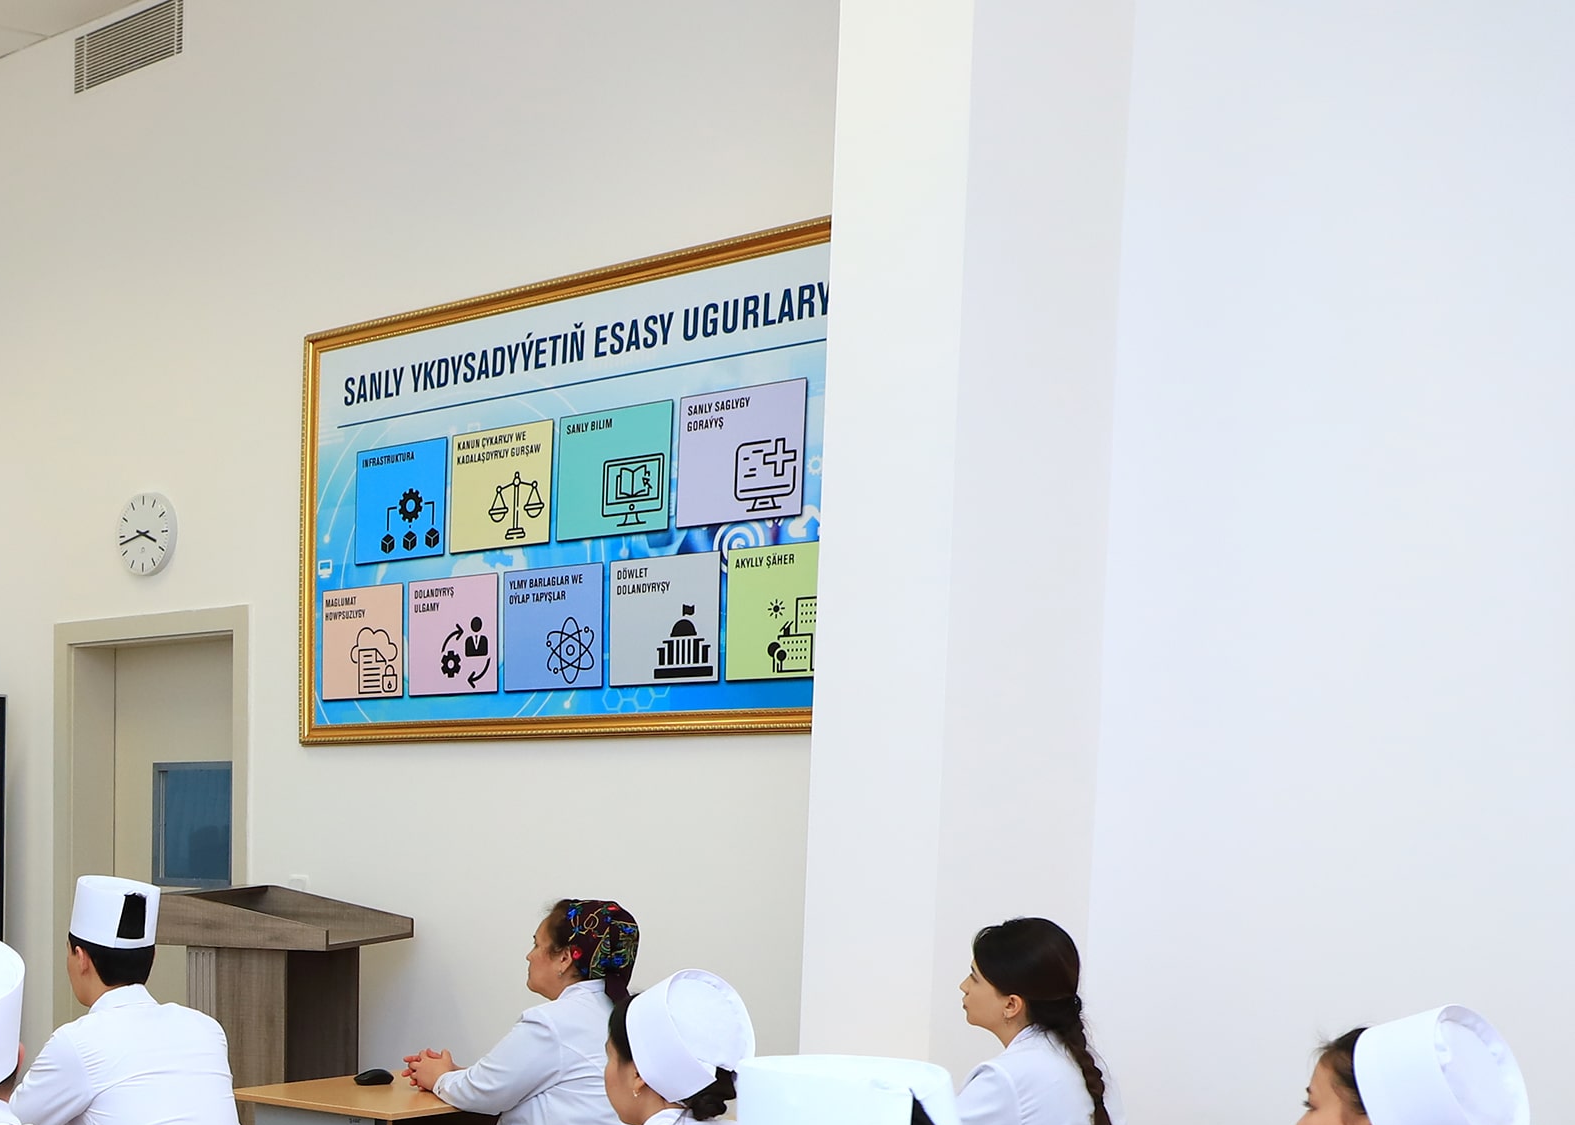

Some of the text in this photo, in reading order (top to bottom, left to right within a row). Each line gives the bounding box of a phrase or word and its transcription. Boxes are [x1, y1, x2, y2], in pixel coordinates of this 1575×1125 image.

[344, 366, 403, 406] SANLY
[412, 322, 584, 391] YKDYSADYÝETIŇ
[595, 312, 674, 358] ESASY
[688, 397, 750, 416] SANLY SAGLYGY
[567, 419, 612, 434] SANLY BILIM
[687, 416, 724, 432] GORAÝYŞ
[458, 438, 479, 451] KANUN
[516, 431, 526, 441] WE
[363, 452, 415, 468] INFRASTRUKTURA
[735, 553, 795, 569] AKYLLY ŞÄHER
[617, 567, 647, 580] DÖWLET
[509, 574, 583, 590] YLMY BARLAGLAR WE
[617, 581, 670, 595] DOLANDYRYŞY
[415, 587, 454, 599] DOLANDYRYŞ
[532, 590, 565, 603] TAPYŞLAR
[325, 596, 356, 608] MAGLUMAT
[414, 603, 439, 613] ULGAMY
